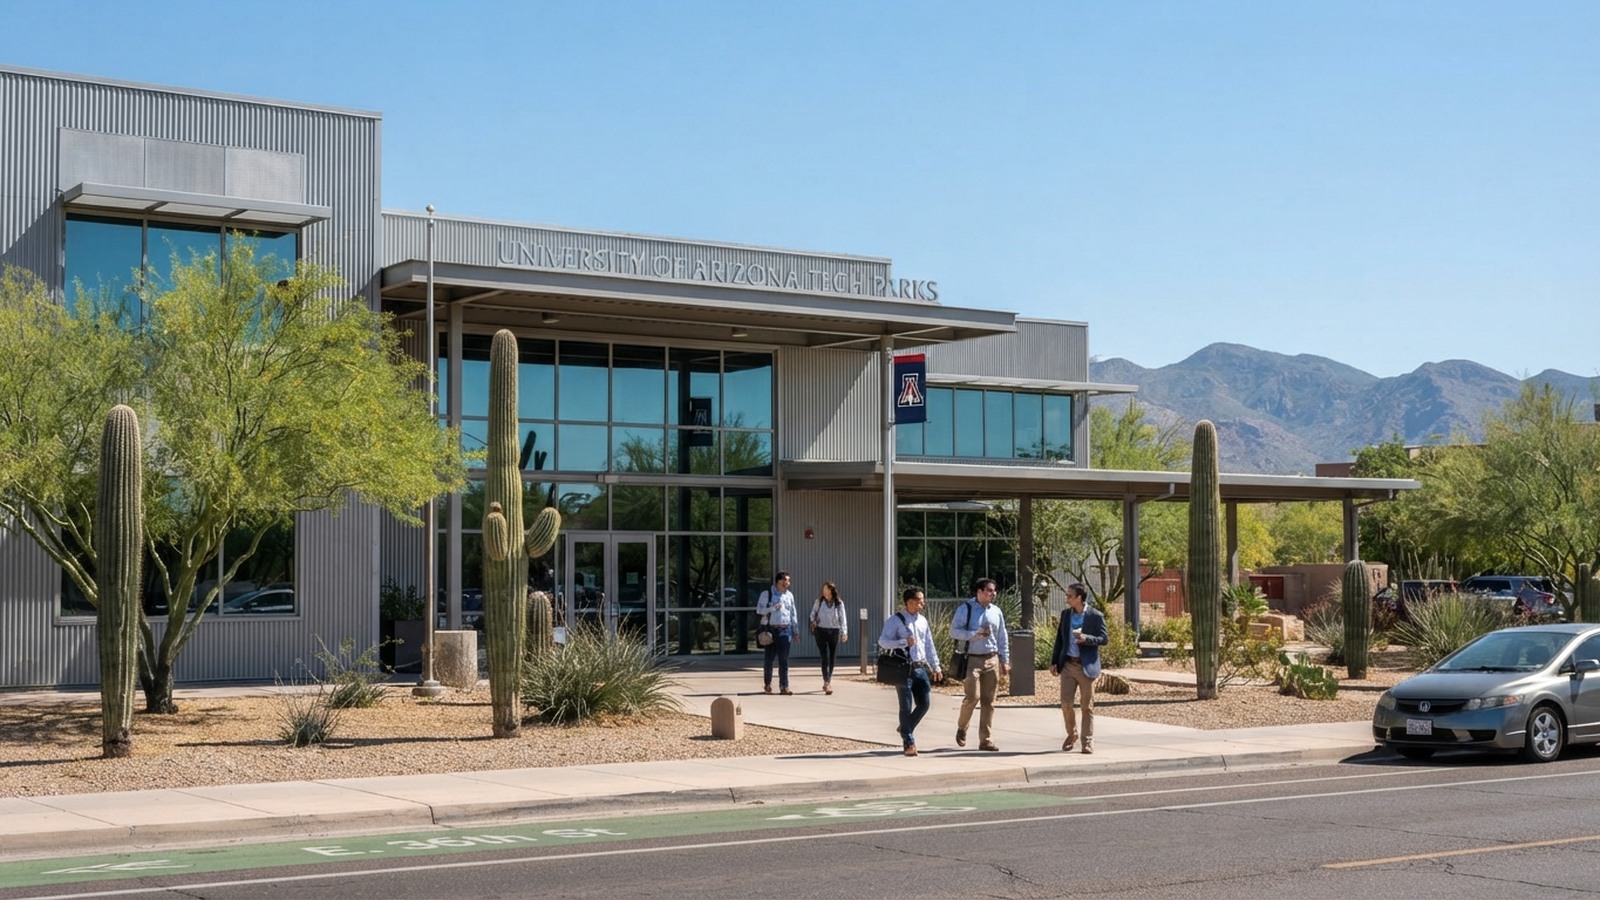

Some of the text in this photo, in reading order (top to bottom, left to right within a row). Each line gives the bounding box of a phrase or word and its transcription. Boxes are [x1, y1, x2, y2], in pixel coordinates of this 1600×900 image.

[499, 240, 646, 275] UNIVERSITY
[693, 259, 799, 289] ARIZONA
[808, 269, 861, 294] TECH
[874, 276, 938, 301] PARKS
[386, 834, 538, 850] 36th
[542, 828, 627, 838] St
